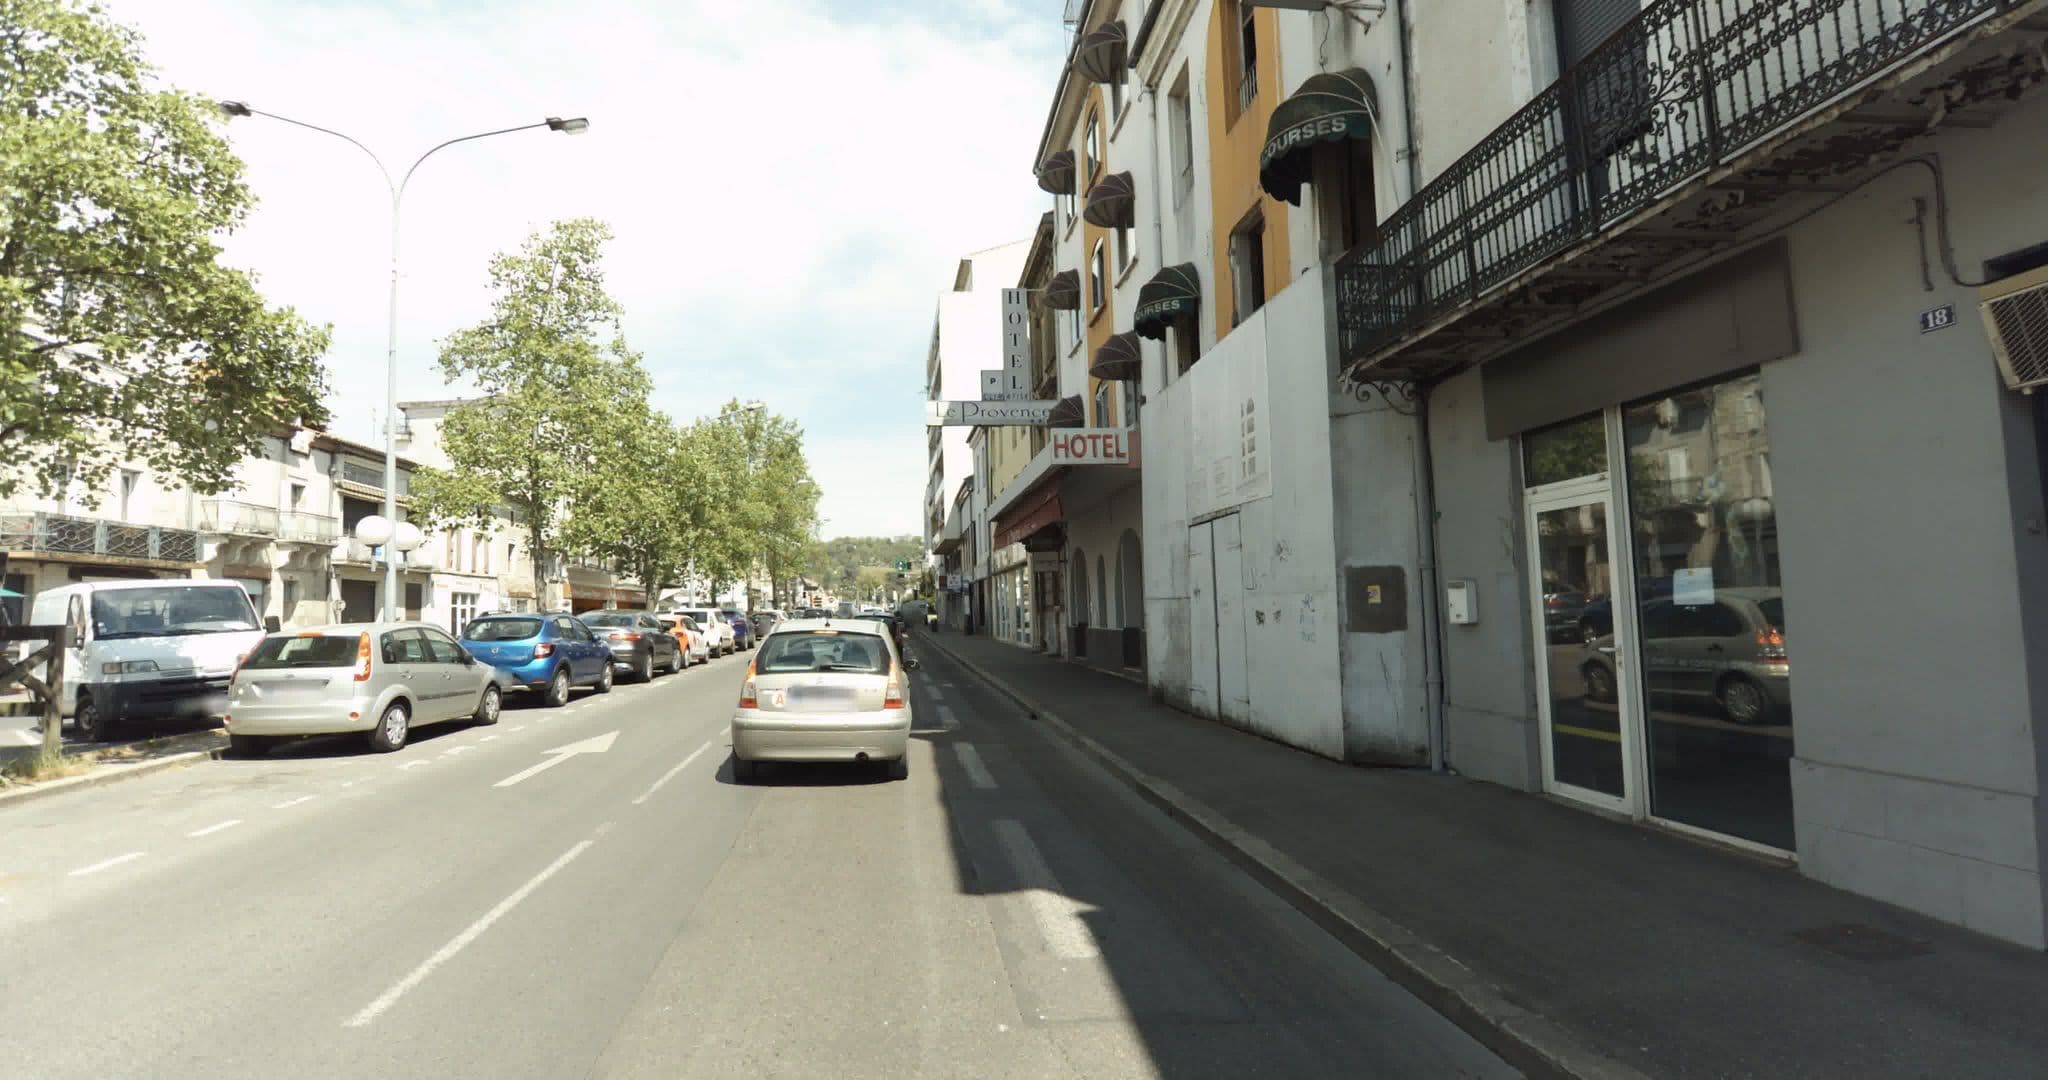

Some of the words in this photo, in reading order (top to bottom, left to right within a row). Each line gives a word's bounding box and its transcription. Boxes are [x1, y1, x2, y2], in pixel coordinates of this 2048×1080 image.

[1927, 308, 1947, 328] 18
[1007, 290, 1023, 390] HOTEL
[936, 402, 957, 418] Le
[961, 402, 1050, 423] Provence
[1053, 434, 1127, 460] HOTEL
[775, 694, 785, 705] A
